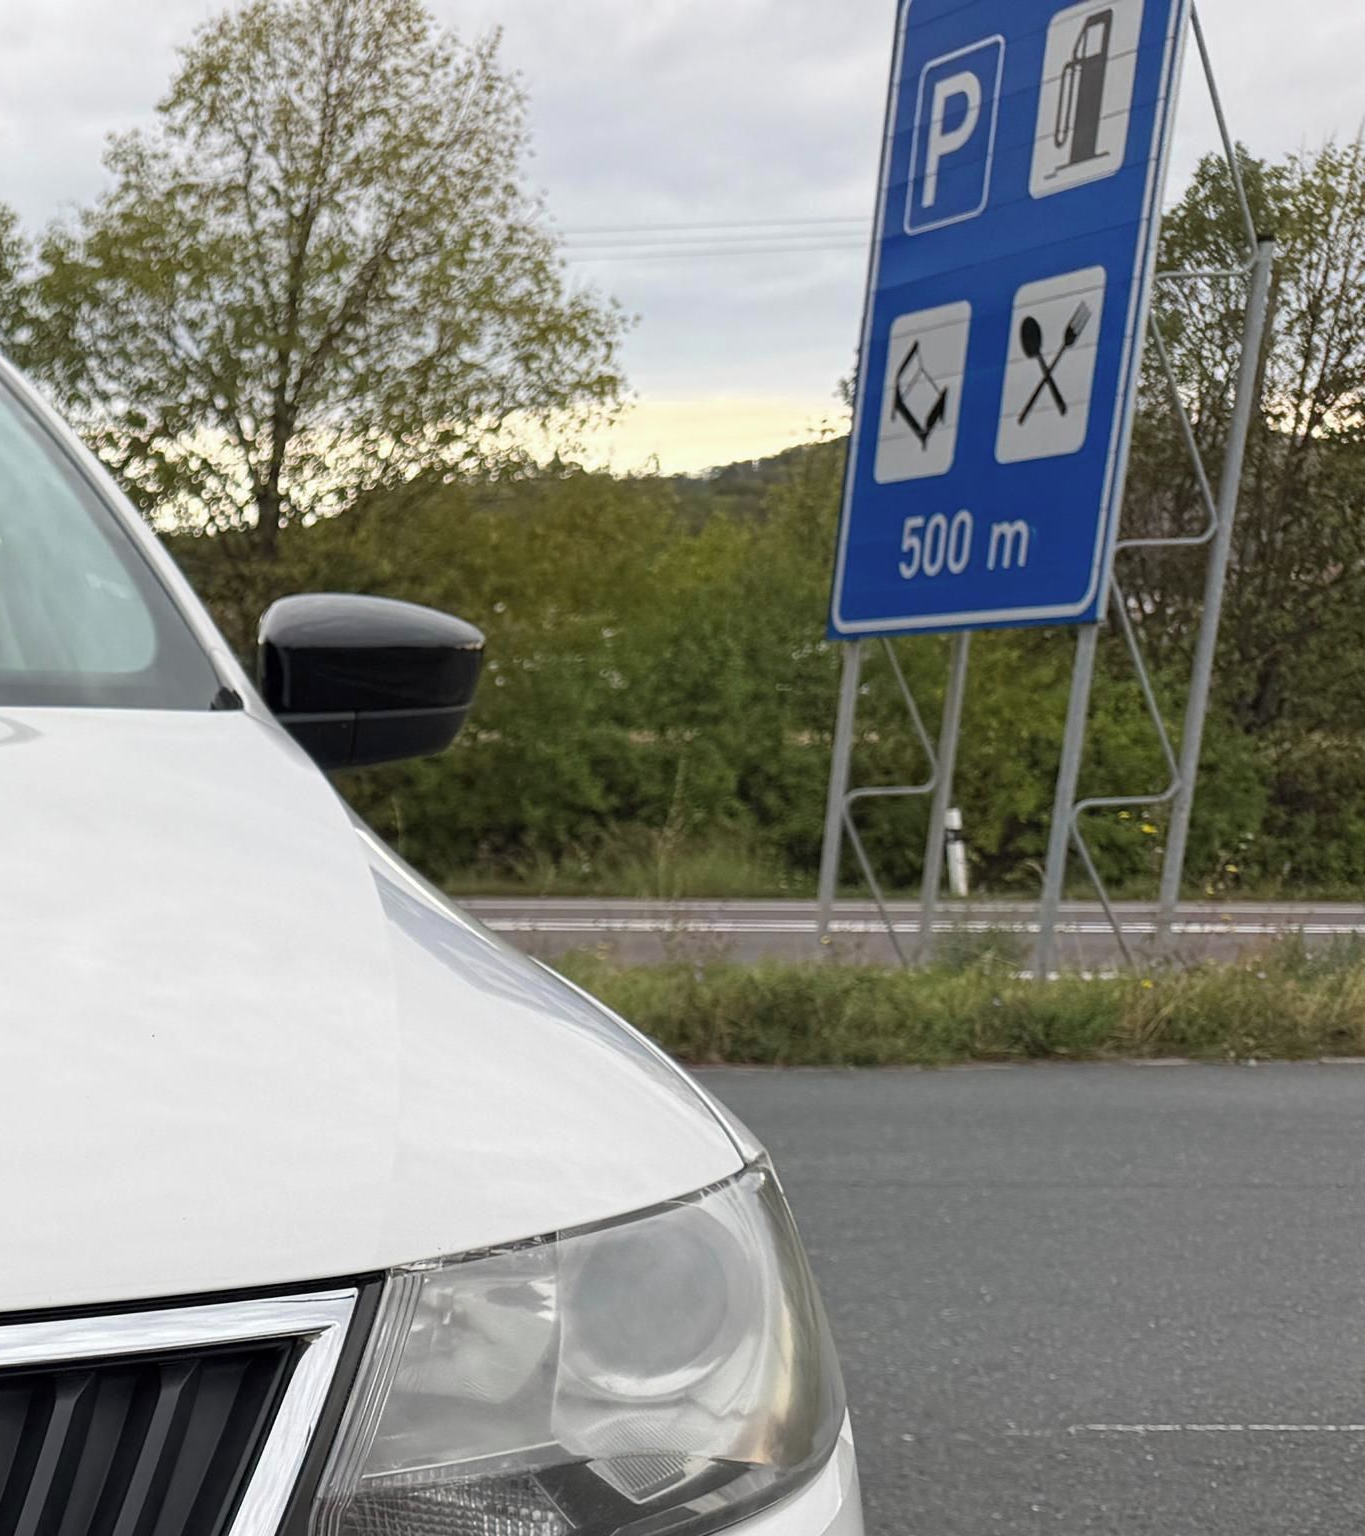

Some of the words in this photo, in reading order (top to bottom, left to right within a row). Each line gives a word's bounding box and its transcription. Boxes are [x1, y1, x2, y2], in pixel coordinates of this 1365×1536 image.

[921, 70, 982, 209] P
[898, 509, 973, 579] 500
[987, 517, 1030, 571] m
